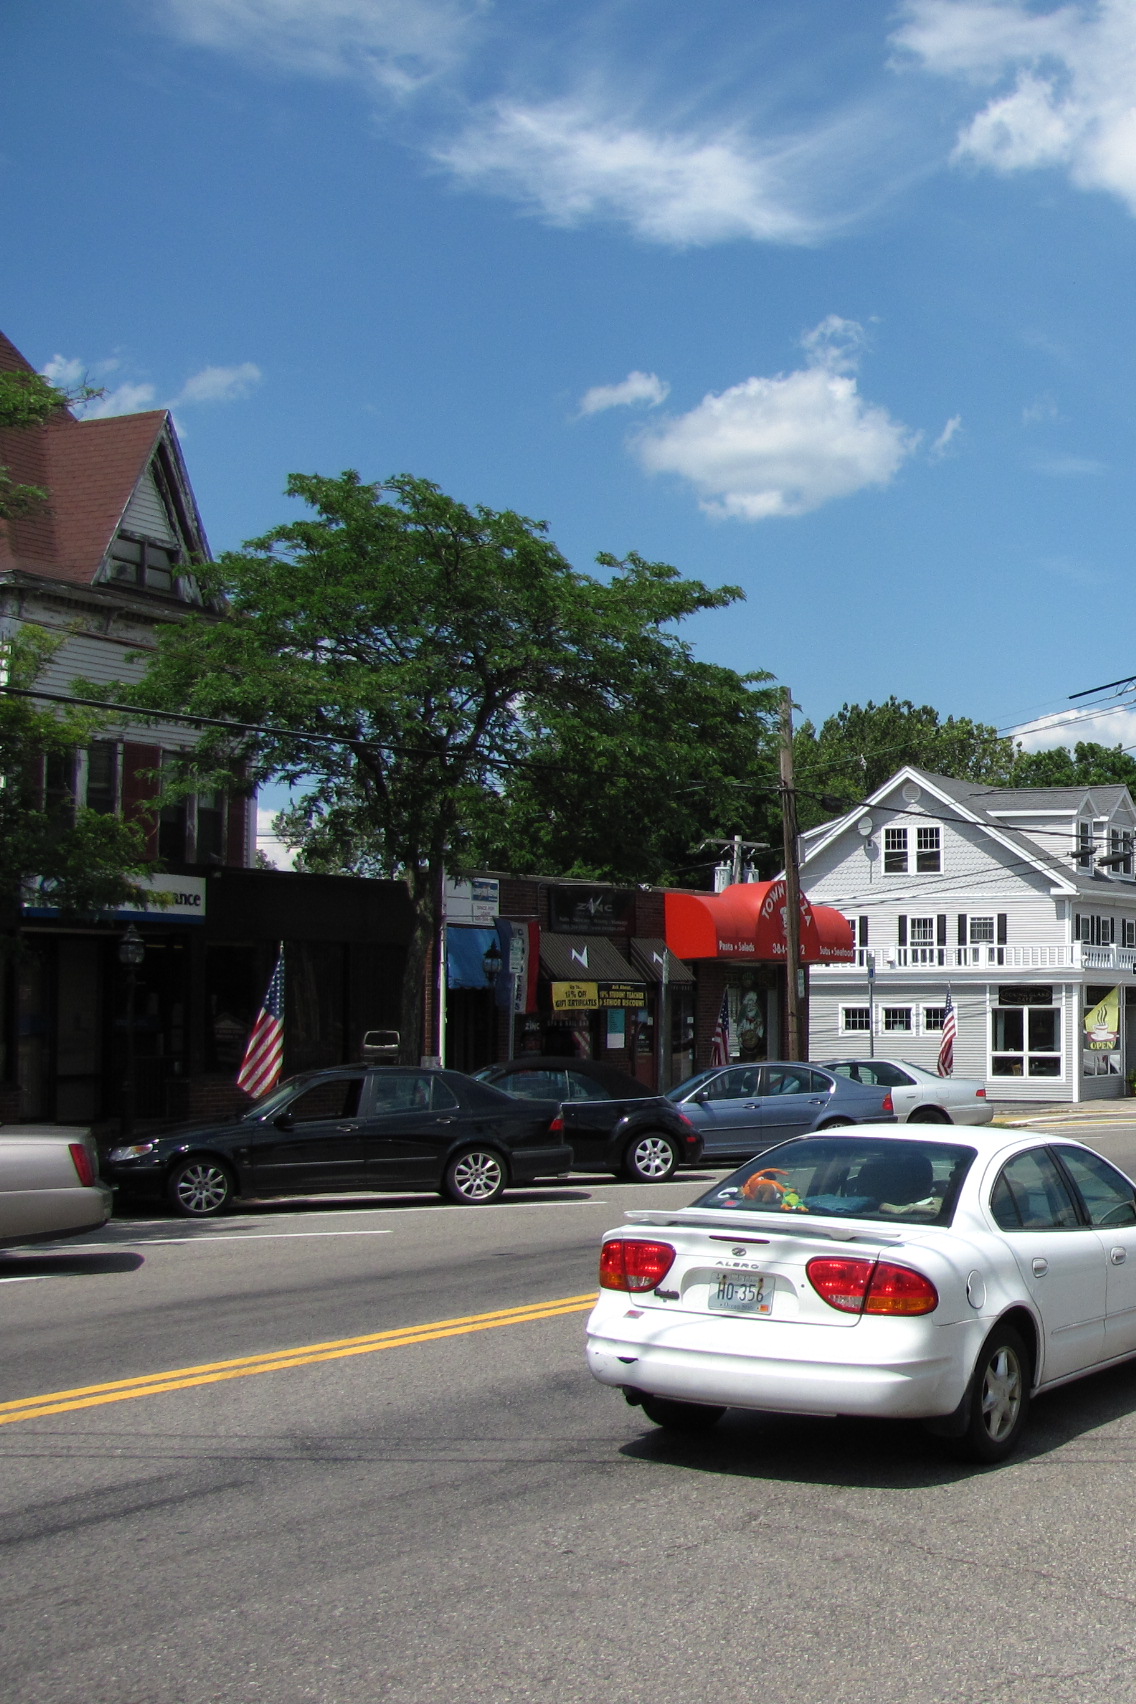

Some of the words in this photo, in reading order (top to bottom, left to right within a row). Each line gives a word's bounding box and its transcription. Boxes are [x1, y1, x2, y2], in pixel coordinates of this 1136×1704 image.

[762, 883, 785, 920] TOWN
[1090, 1041, 1114, 1049] OPEN
[715, 1261, 759, 1269] ALERO
